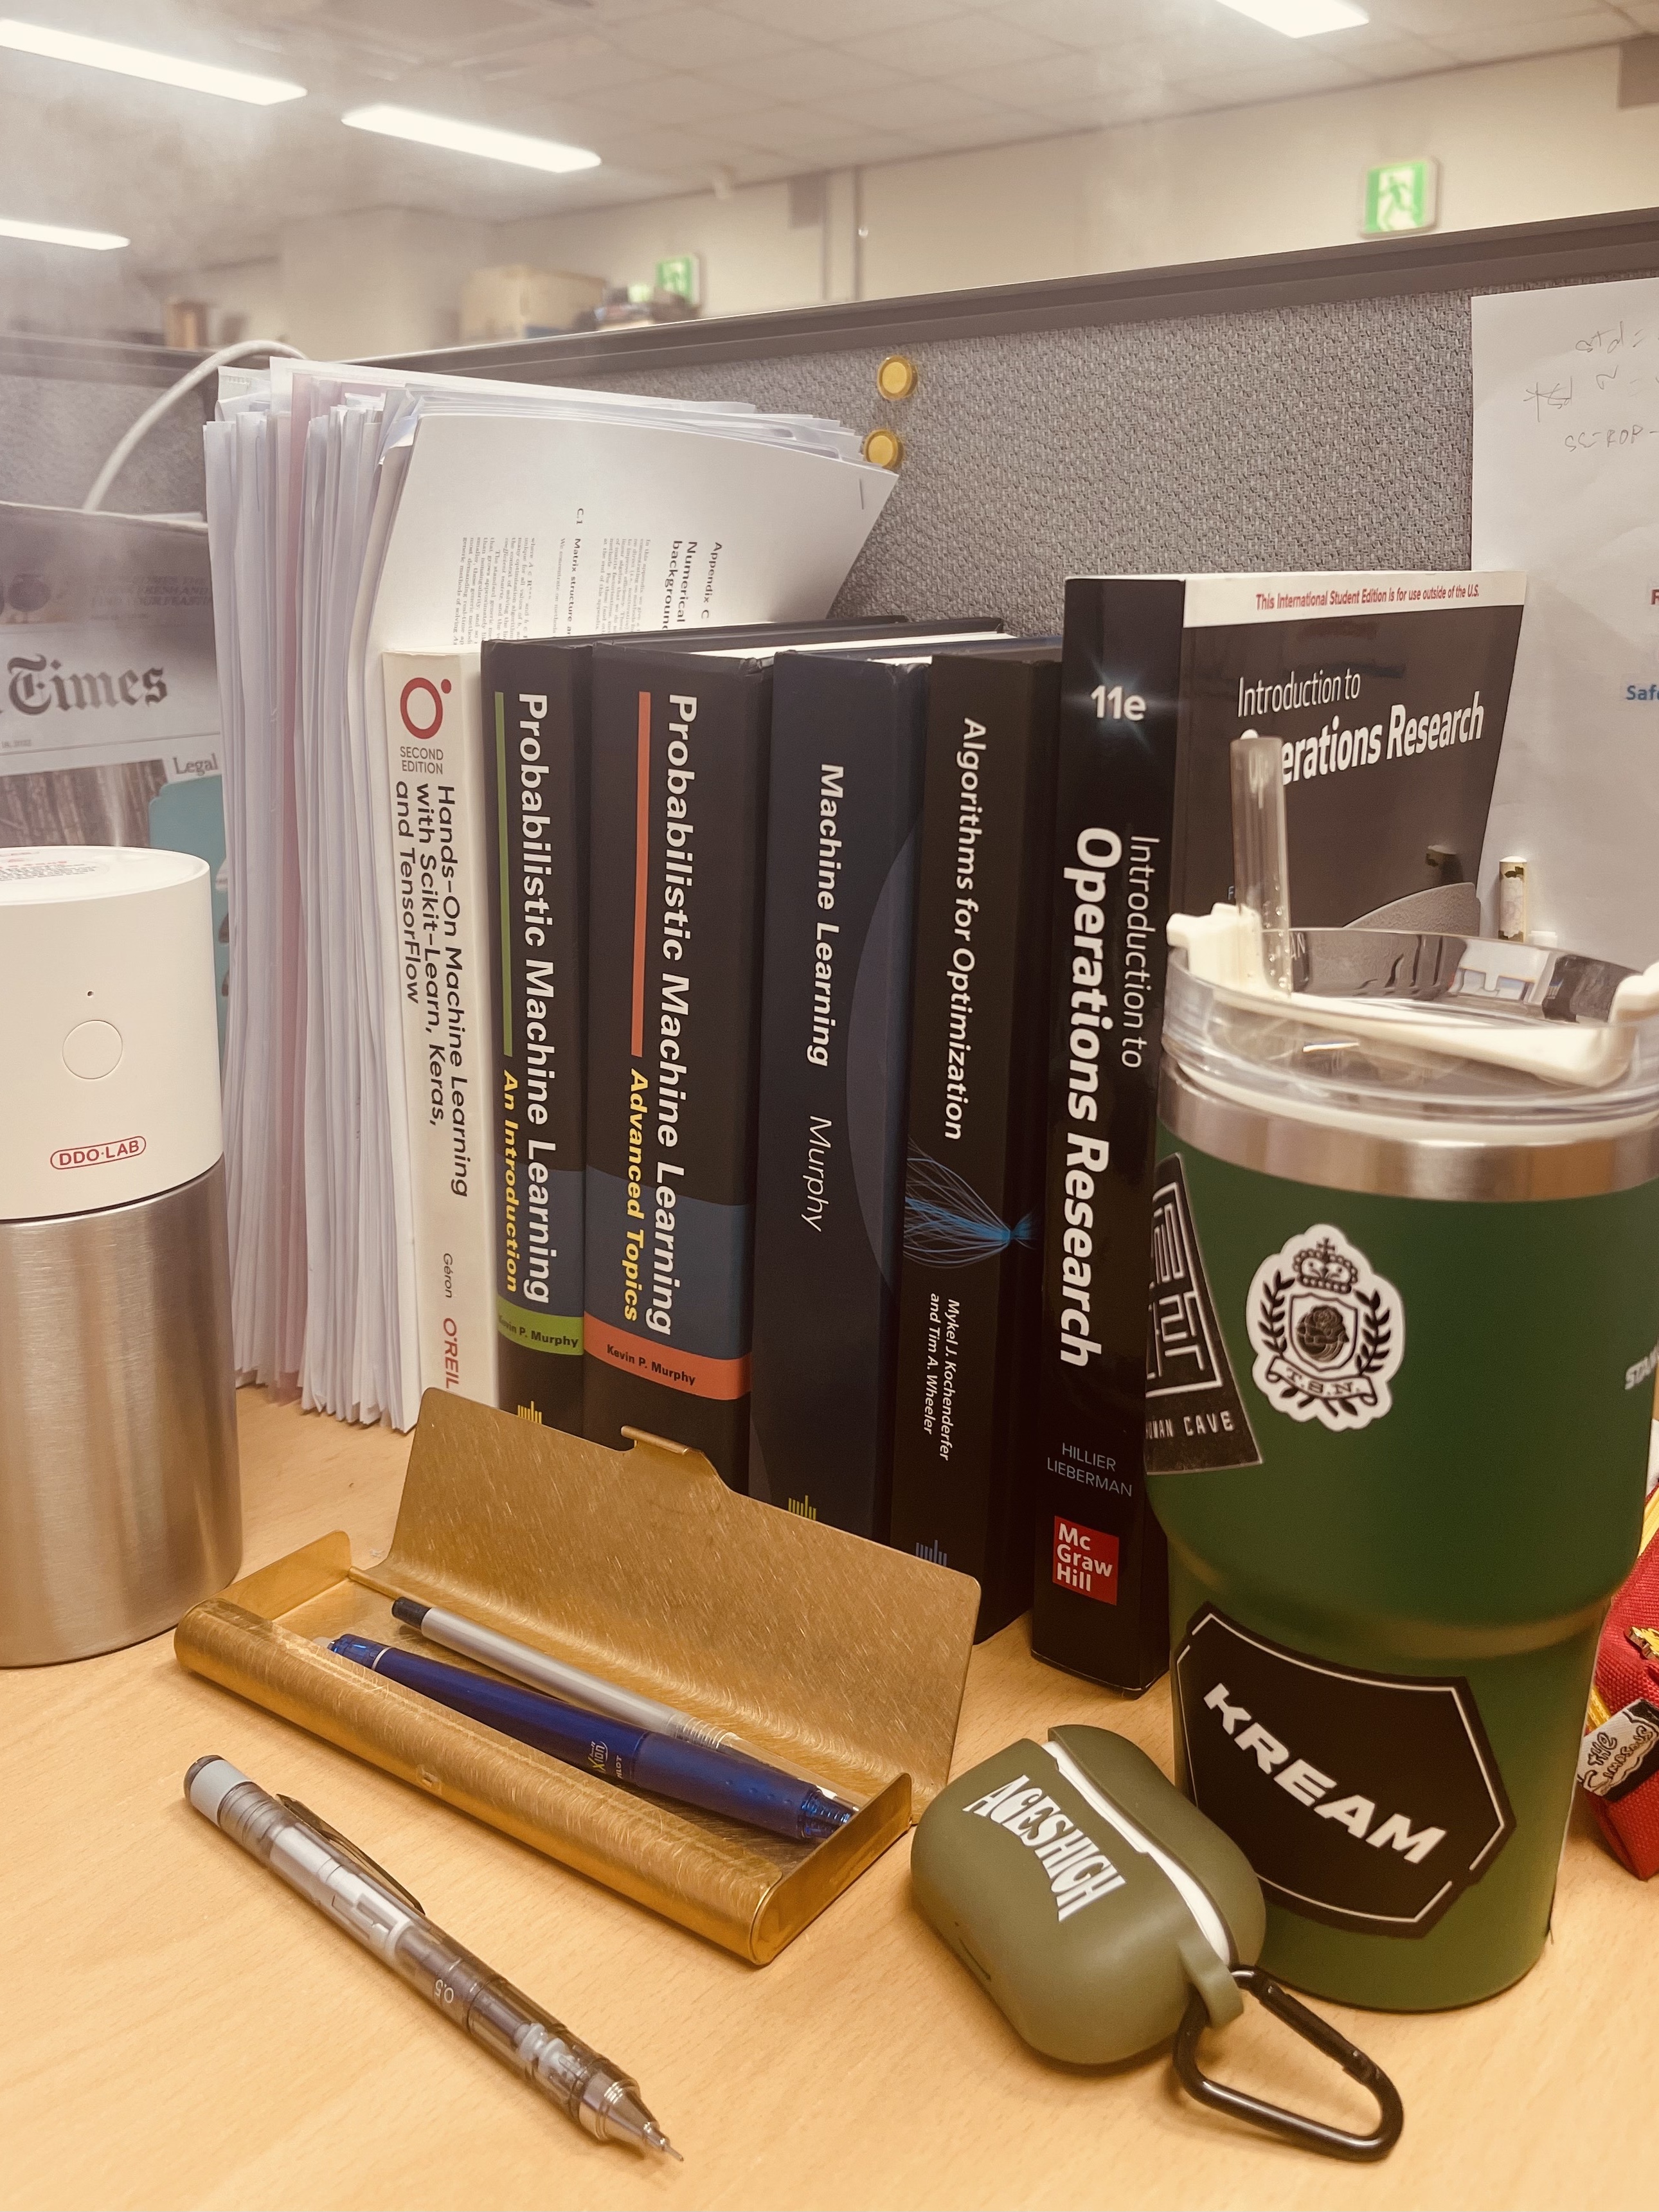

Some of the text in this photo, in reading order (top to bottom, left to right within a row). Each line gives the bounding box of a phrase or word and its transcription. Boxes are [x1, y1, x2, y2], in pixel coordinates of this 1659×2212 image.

[572, 539, 581, 572] Matrix
[677, 541, 697, 622] Numerical
[701, 542, 722, 619] Appendix C
[568, 577, 576, 622] structure
[1256, 584, 1480, 610] This International Student Edition is for use outside of the U.S.
[8, 654, 167, 715] Times
[1091, 685, 1146, 721] 11e
[1237, 668, 1361, 717] Introduction to
[1626, 684, 1659, 700] Saf
[400, 746, 444, 760] SECOND
[1386, 690, 1485, 760] Research
[173, 753, 218, 777] Legal
[402, 760, 444, 775] EDITION
[396, 781, 421, 1003] and TensorFlow
[807, 764, 844, 1067] Machine Learning
[417, 783, 446, 1126] with Scikit-Learn, Keras,
[944, 717, 987, 1140] Algorithms for Optimization
[1121, 835, 1160, 1068] Introduction to
[438, 786, 471, 1197] Hands-On Machine Learning
[518, 694, 557, 1304] Probabilistic Machine Learning
[647, 694, 698, 1336] Probabilistic Machine Learning
[1060, 827, 1122, 1367] Operations Research
[503, 1070, 519, 1293] An Introduction
[622, 1068, 649, 1322] Advanced Topics
[801, 1115, 832, 1233] Murphy
[444, 1254, 455, 1299] Géron
[443, 1318, 460, 1389] O'REIL
[519, 1326, 528, 1338] P.
[530, 1330, 578, 1348] Murphy
[606, 1344, 696, 1386] Kevin P. Murphy
[924, 1293, 941, 1435] and Tim A. Wheeler
[940, 1299, 960, 1461] Mykel J. Kochenderfer
[1183, 1410, 1234, 1436] CAVE
[1047, 1457, 1133, 1497] LIEBERMAN
[1062, 1443, 1116, 1471] HILLIER
[1057, 1544, 1113, 1578] Graw
[1058, 1523, 1091, 1551] Mc
[1057, 1563, 1091, 1592] Hill
[1203, 1682, 1447, 1864] KREAM
